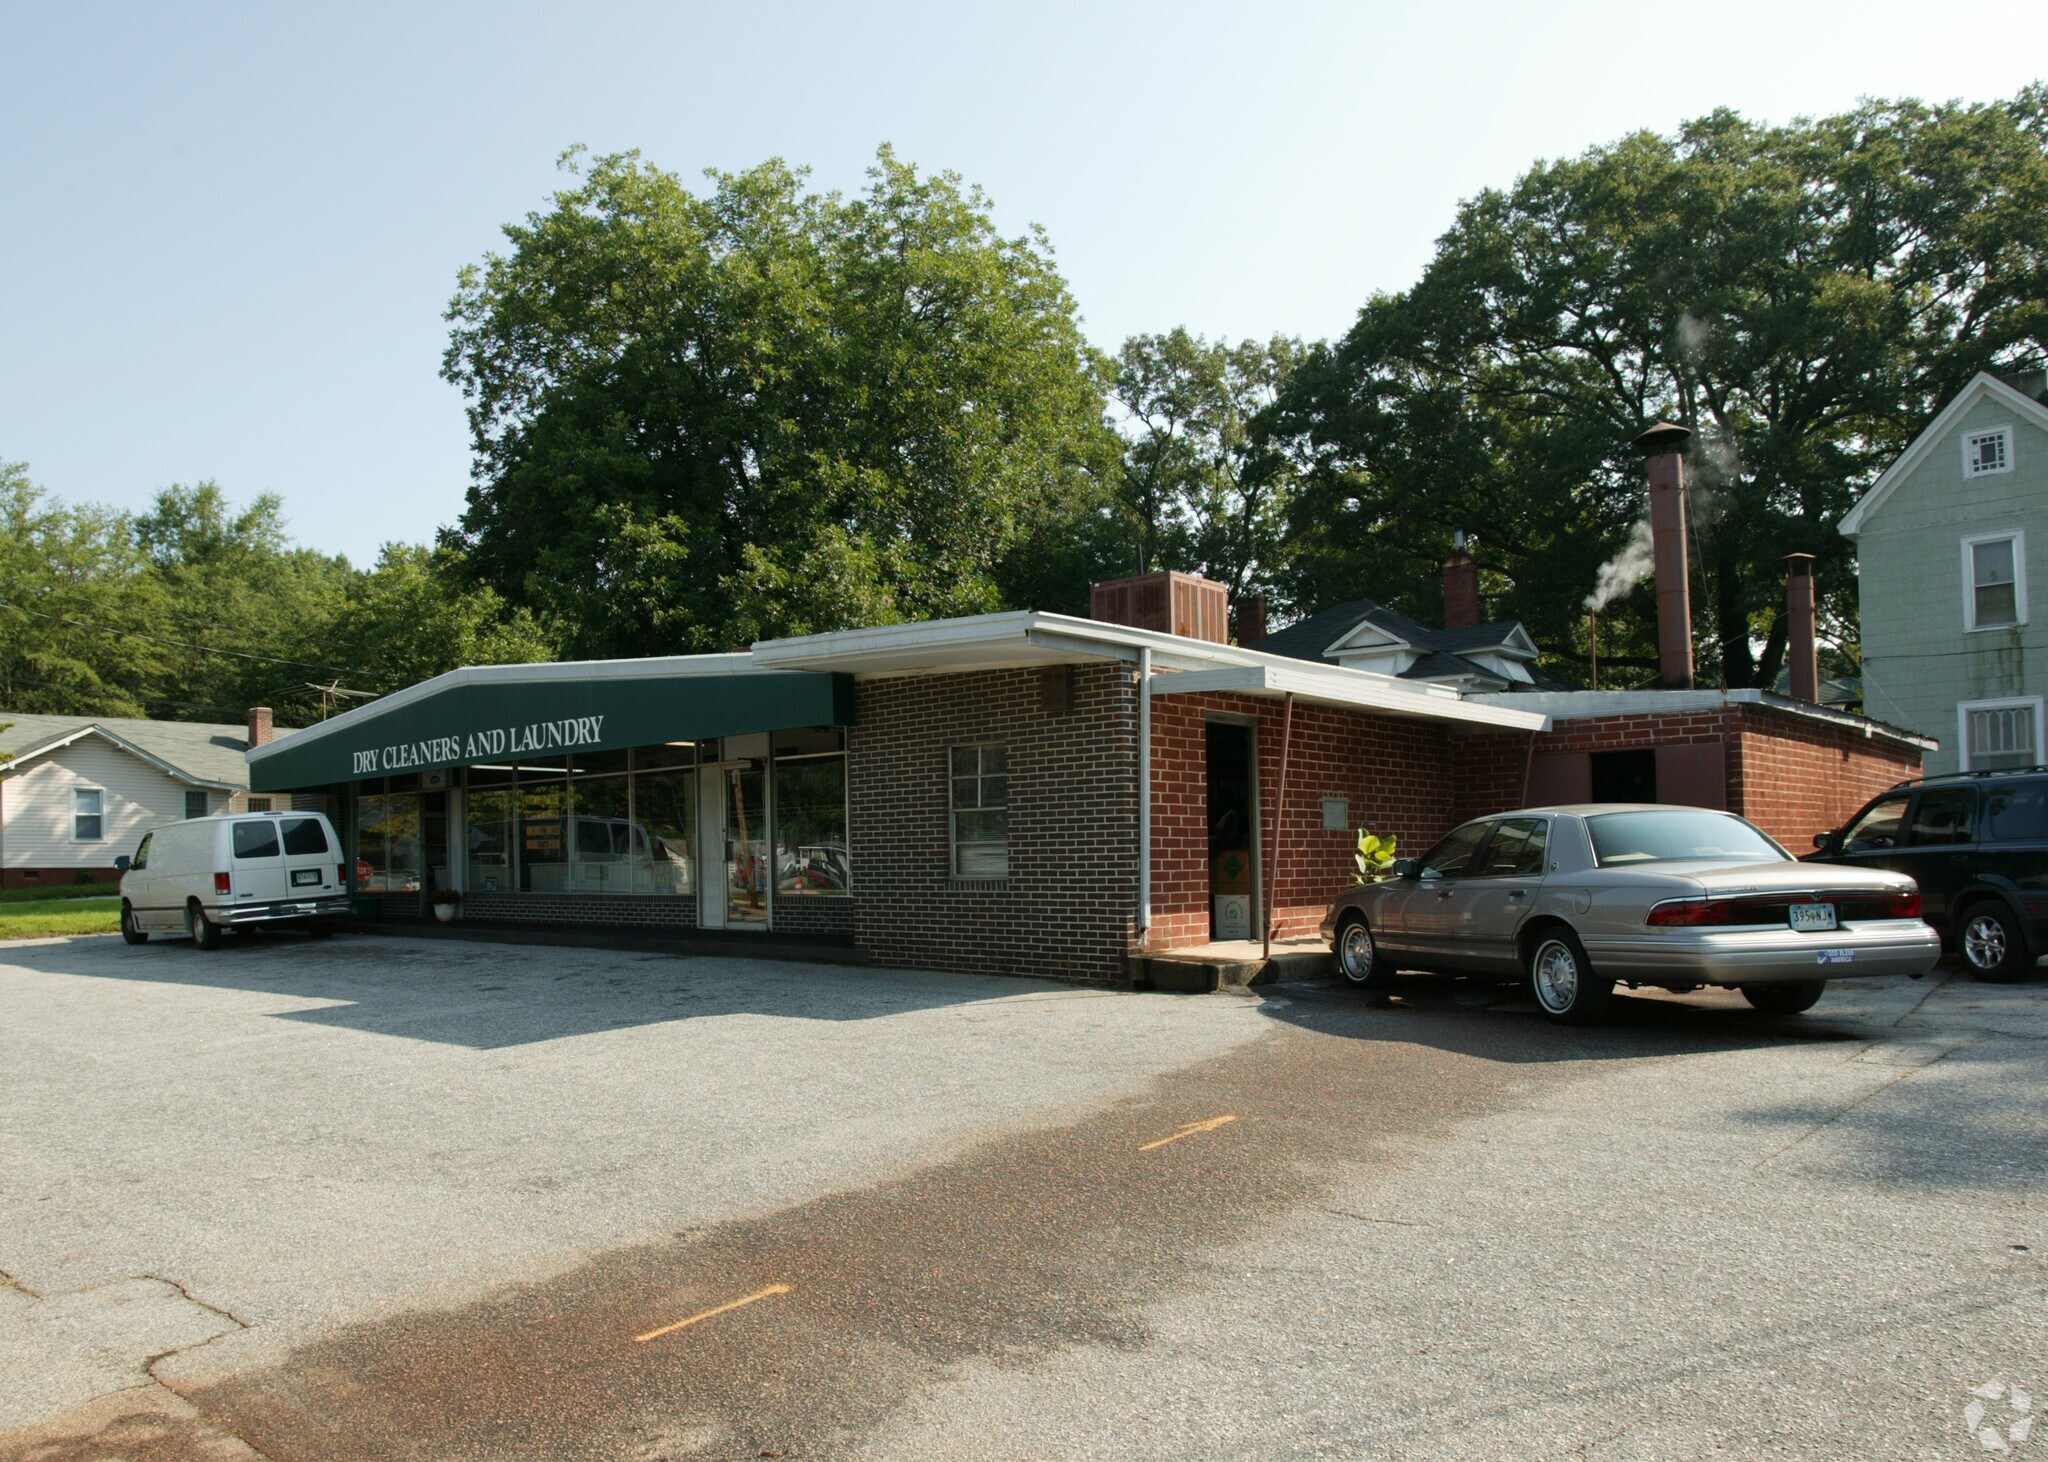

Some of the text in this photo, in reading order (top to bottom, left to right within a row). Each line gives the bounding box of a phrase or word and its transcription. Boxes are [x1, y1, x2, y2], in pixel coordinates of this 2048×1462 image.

[353, 715, 604, 774] DRY CLEANERS AND LAUNDRY
[1793, 910, 1810, 921] 395
